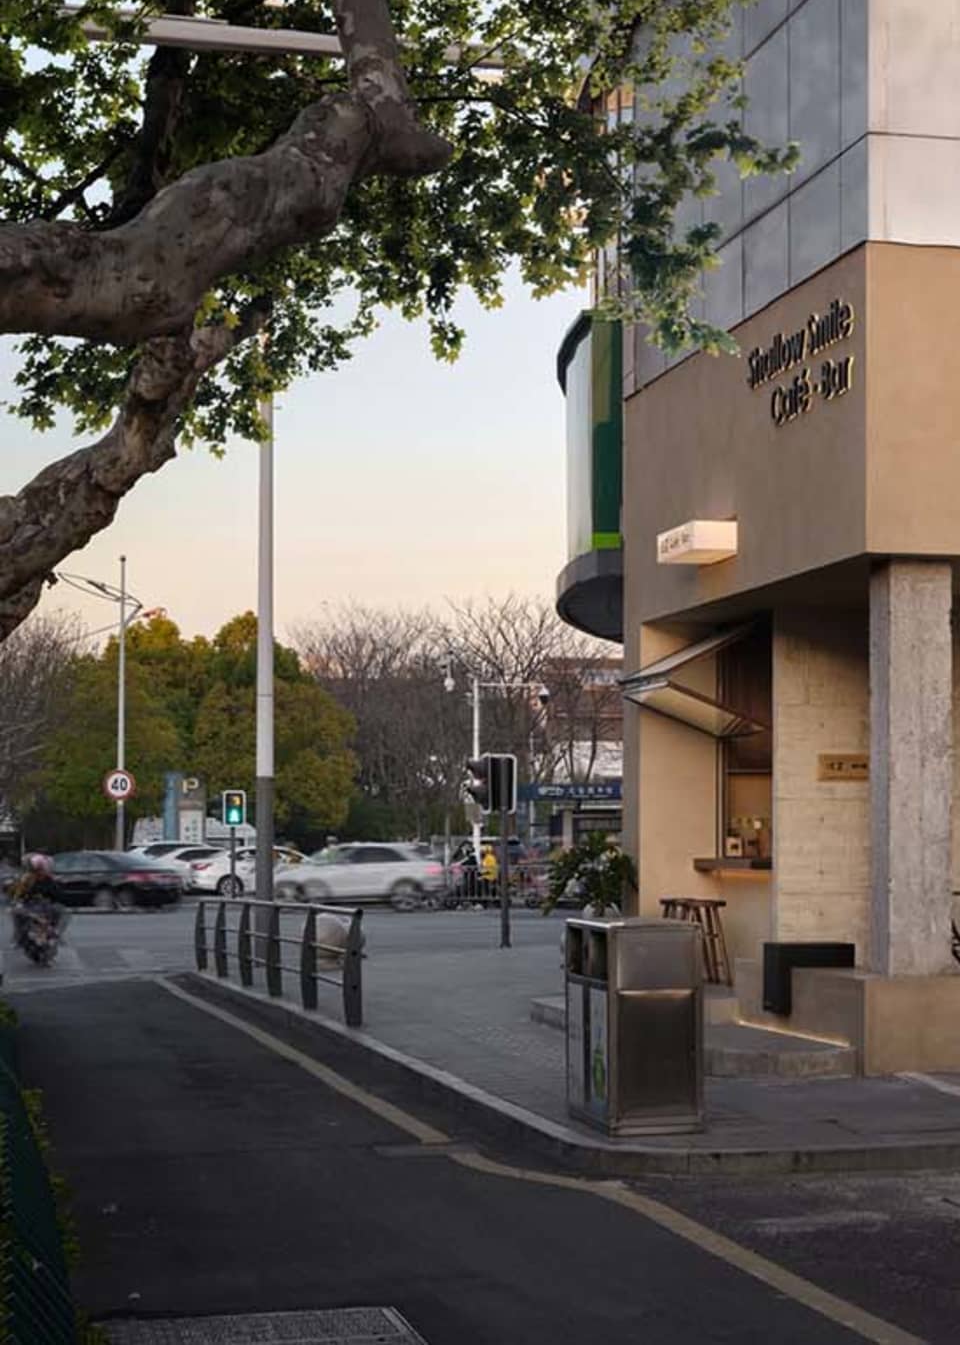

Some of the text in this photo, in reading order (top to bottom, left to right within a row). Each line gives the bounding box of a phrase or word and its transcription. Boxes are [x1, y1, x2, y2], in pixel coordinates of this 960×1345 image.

[808, 299, 855, 355] Smile
[821, 357, 855, 401] Bar
[111, 777, 128, 791] 40
